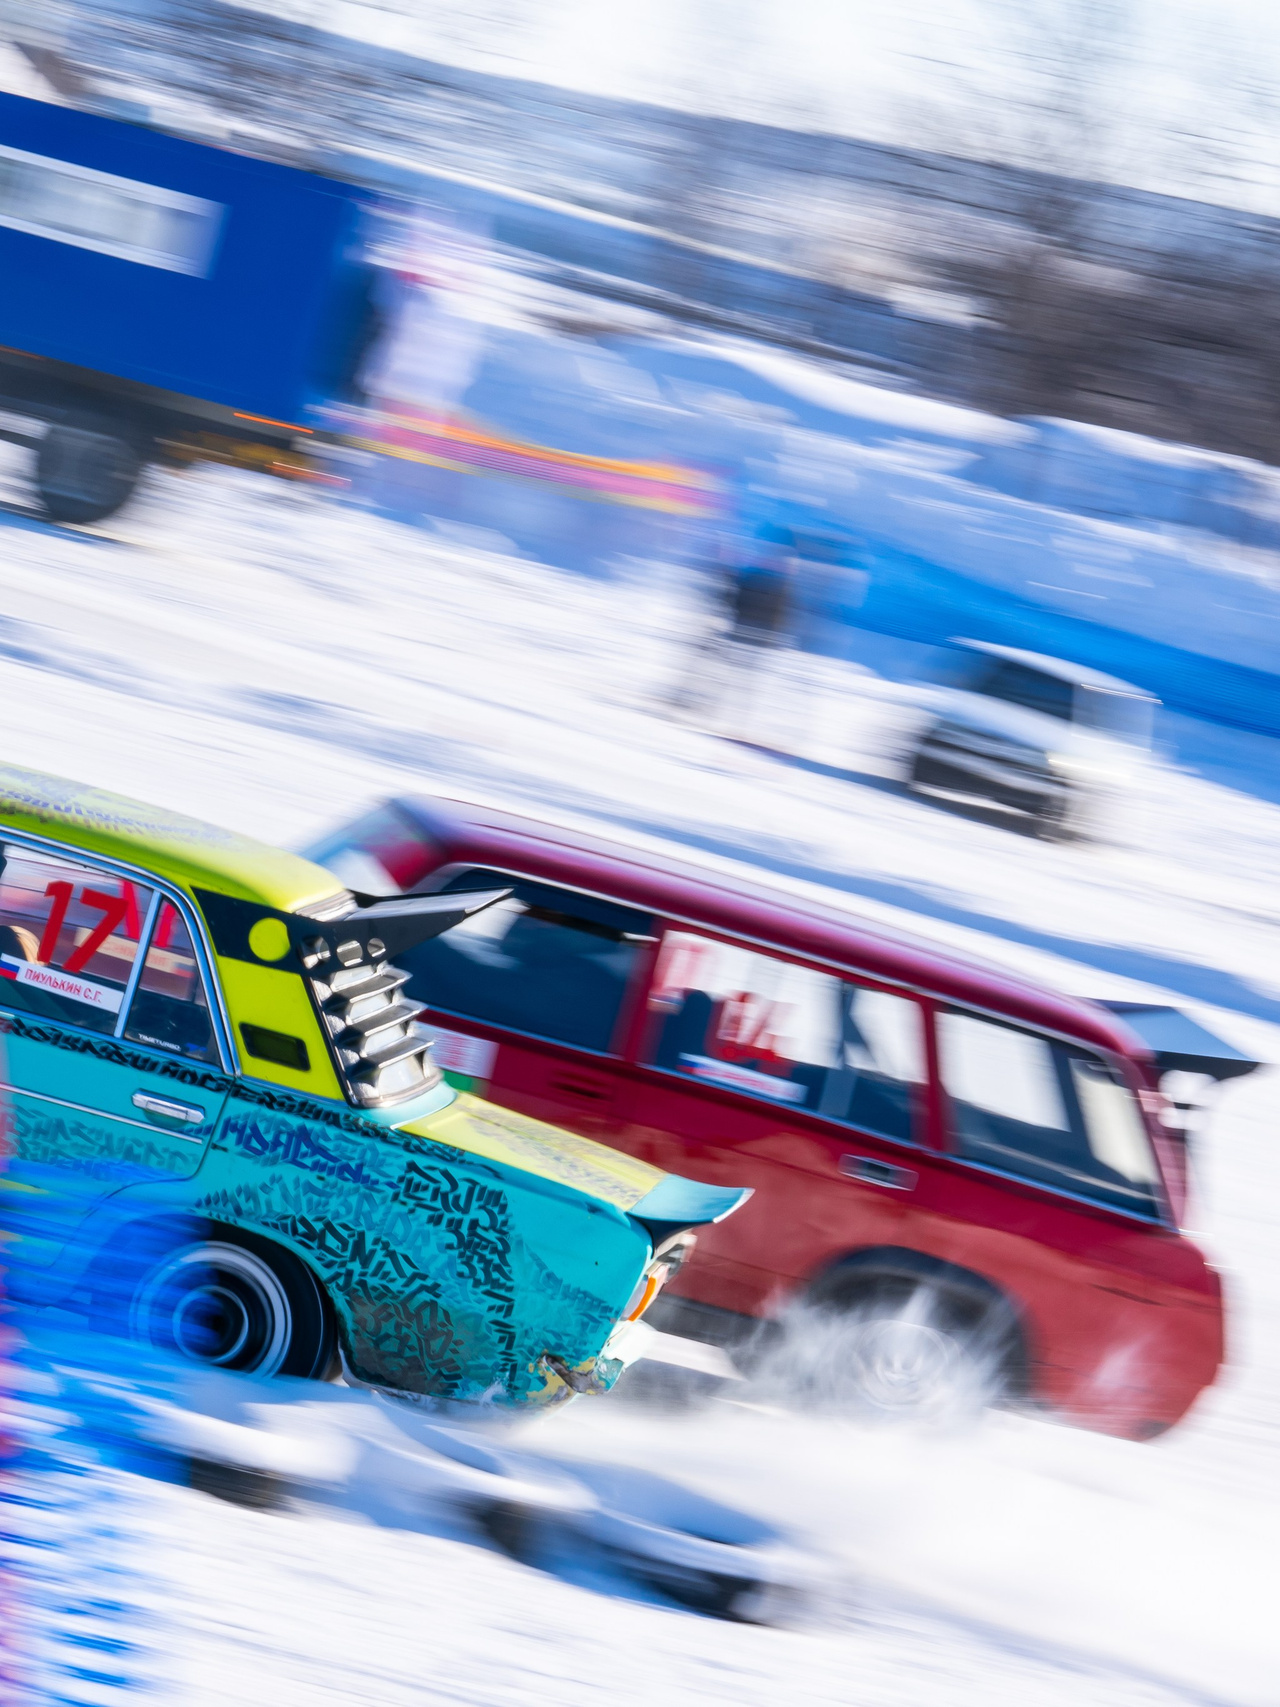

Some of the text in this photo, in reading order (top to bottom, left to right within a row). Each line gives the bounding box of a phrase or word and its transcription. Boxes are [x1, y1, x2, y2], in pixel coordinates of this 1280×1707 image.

[37, 879, 130, 974] 17
[24, 967, 104, 1004] ПИУЛЬКИН С.Г.
